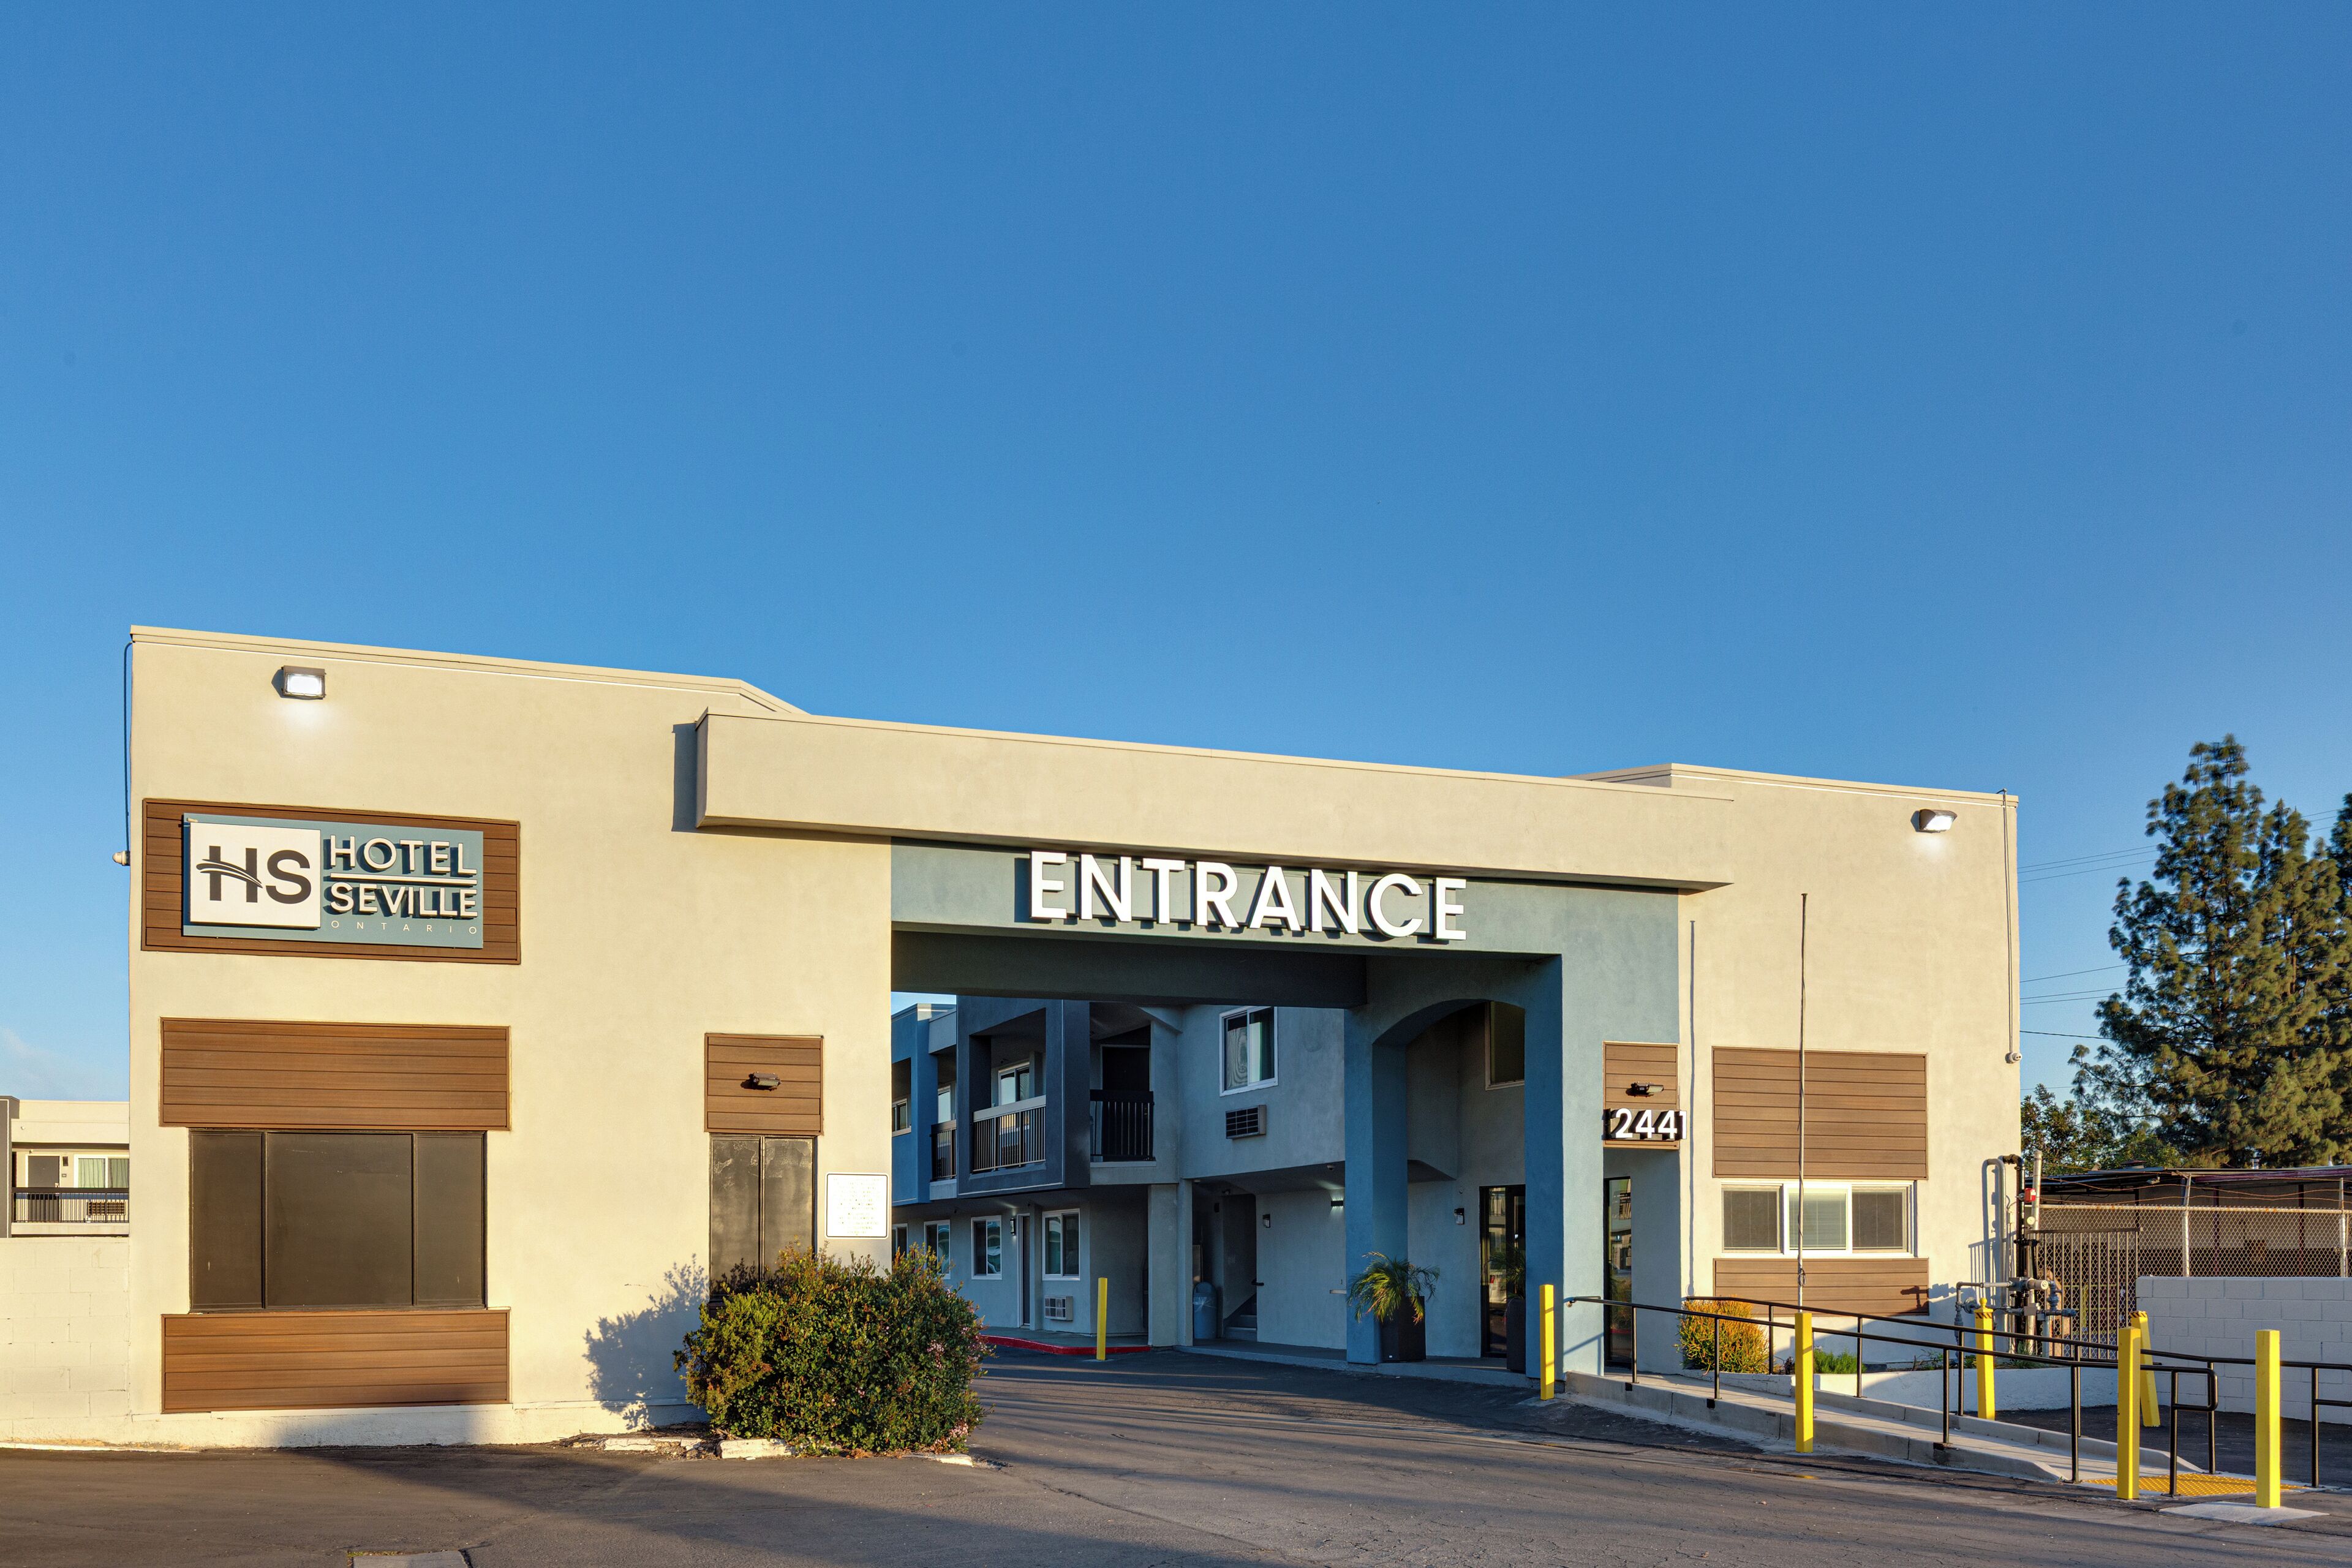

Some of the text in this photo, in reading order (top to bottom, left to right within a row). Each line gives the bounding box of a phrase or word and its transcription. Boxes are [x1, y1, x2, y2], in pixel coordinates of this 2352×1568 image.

[330, 834, 478, 875] HOTEL
[196, 845, 312, 904] HS
[330, 881, 478, 918] SEVILLE
[1030, 850, 1467, 940] ENTRANCE
[331, 920, 477, 935] ONTARIO
[1615, 1107, 1687, 1140] 2441
